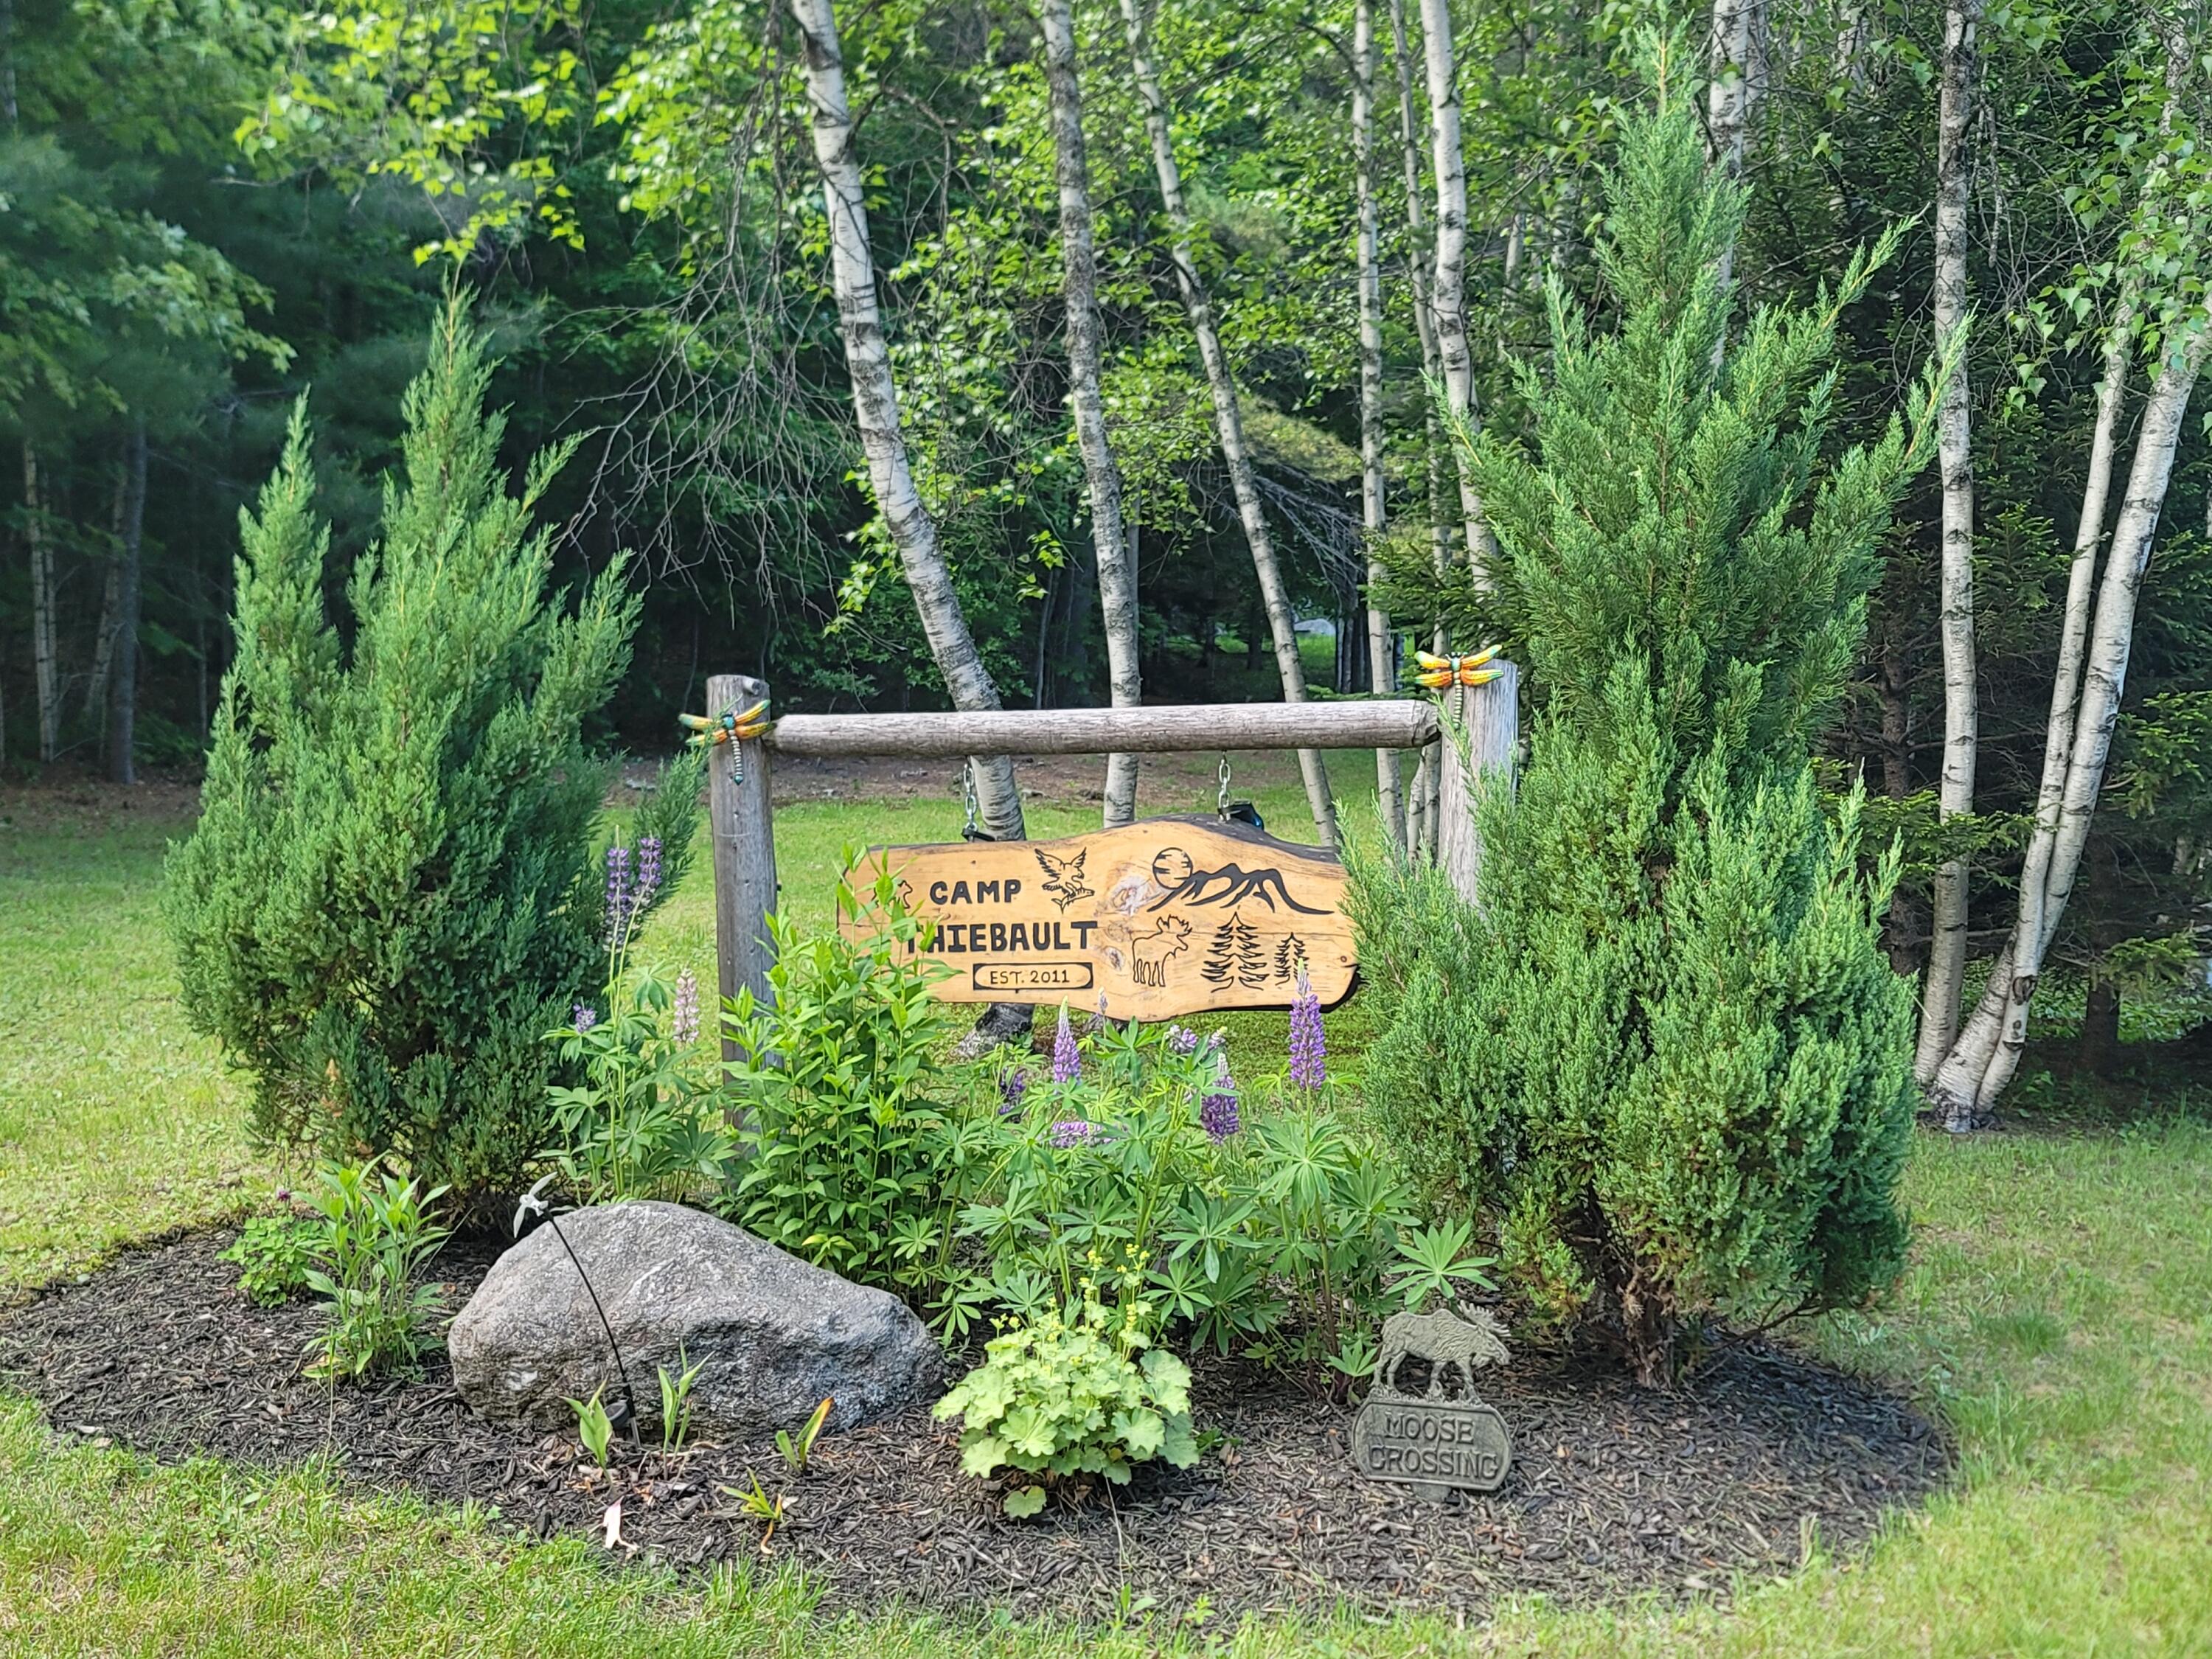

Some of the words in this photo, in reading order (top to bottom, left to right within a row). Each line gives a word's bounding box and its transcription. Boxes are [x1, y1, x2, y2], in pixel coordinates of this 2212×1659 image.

[929, 879, 1022, 905] CAMP
[990, 970, 1025, 985] EST.
[1030, 970, 1070, 984] 2011
[1385, 1411, 1475, 1445] MOOSE
[1368, 1443, 1499, 1480] CROSSING
